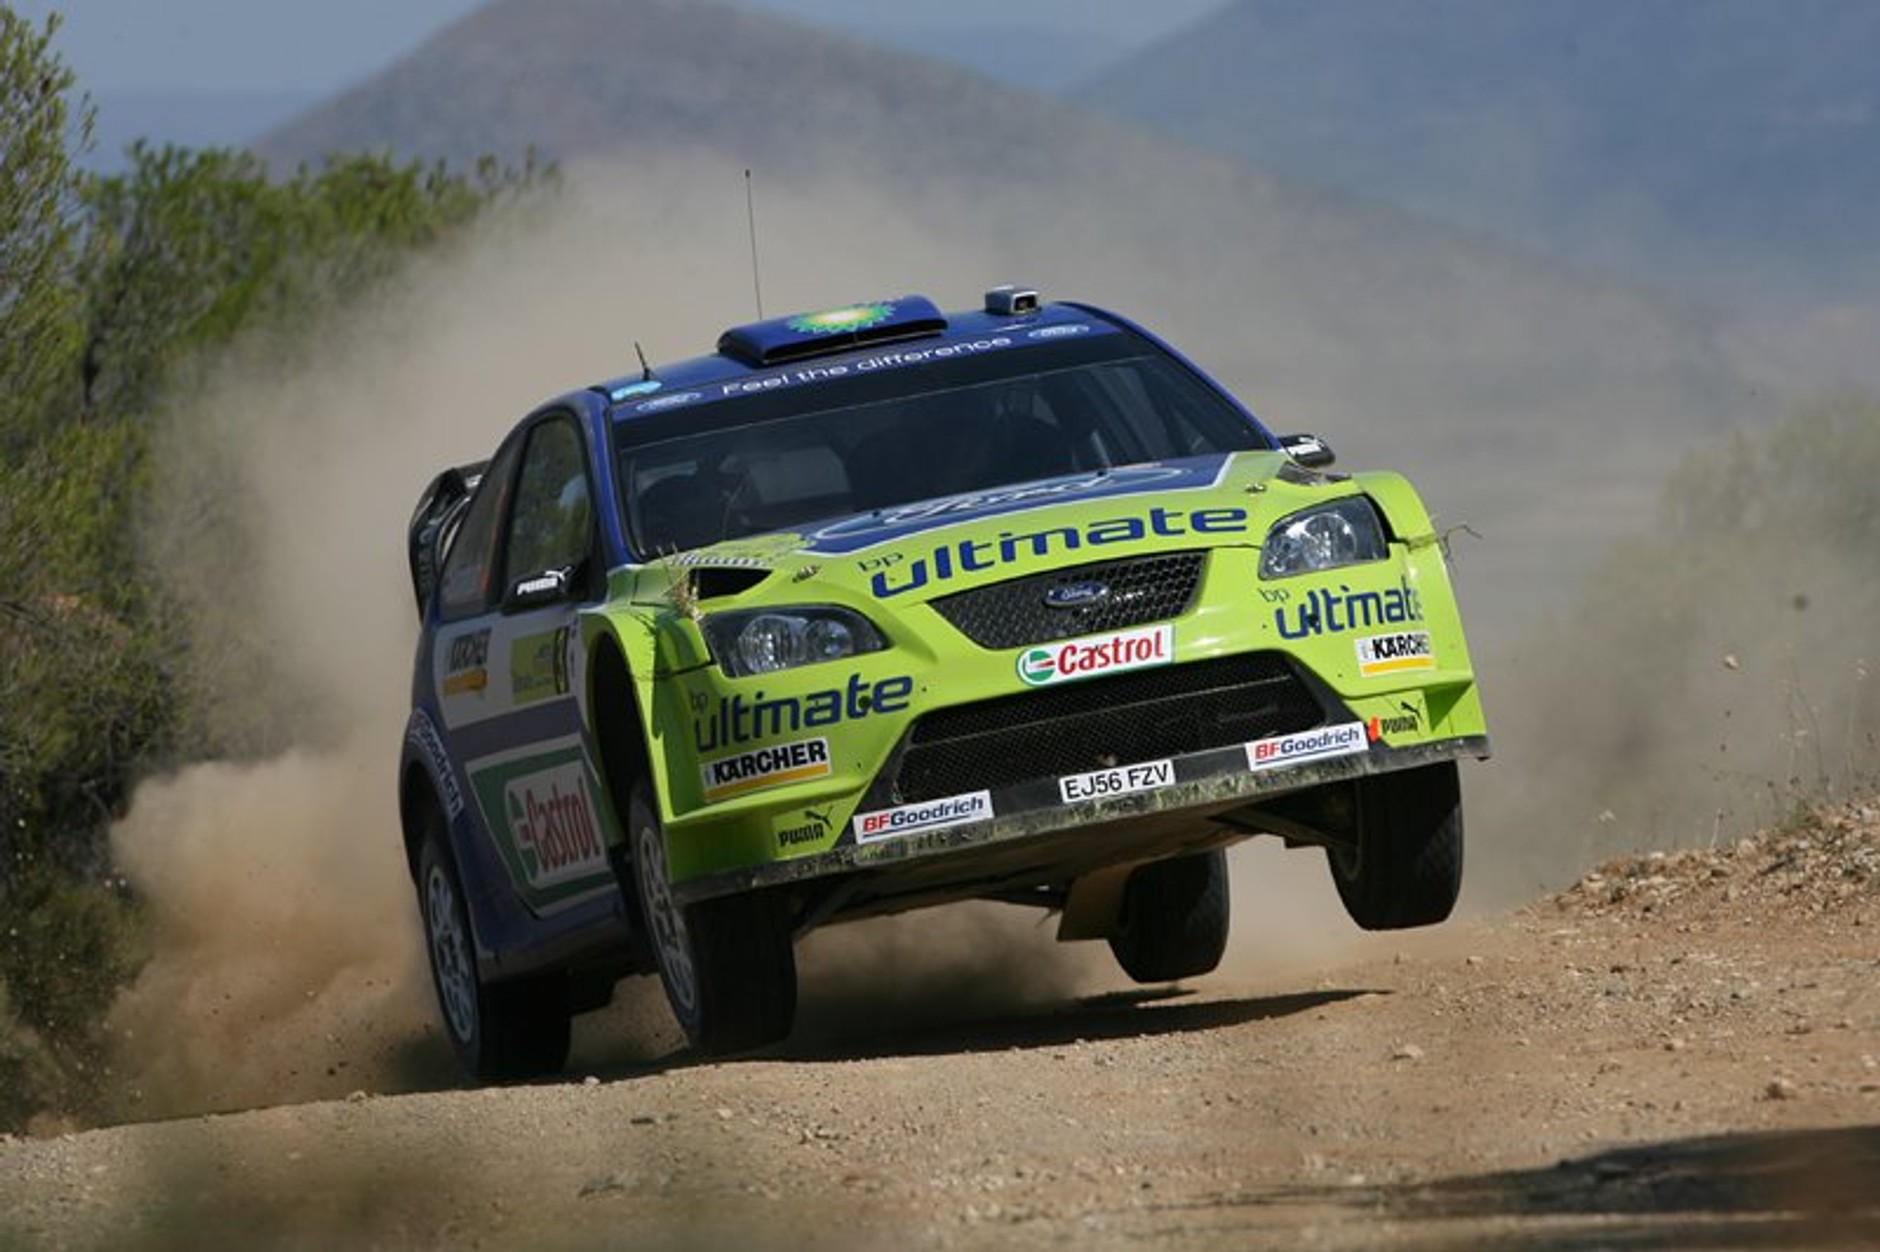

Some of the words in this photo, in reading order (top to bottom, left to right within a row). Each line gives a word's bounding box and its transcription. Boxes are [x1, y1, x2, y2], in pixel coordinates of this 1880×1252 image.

[722, 374, 789, 396] Feel
[797, 365, 848, 382] the
[857, 337, 1012, 371] difference
[858, 553, 904, 573] bp
[870, 507, 1248, 599] ultimate
[1258, 587, 1290, 604] bp
[1057, 629, 1165, 676] Castrol
[695, 673, 913, 753] ultimate
[1254, 727, 1361, 760] BFGoodrich
[1063, 771, 1123, 800] EJ56
[1127, 763, 1169, 788] FZV
[525, 775, 602, 873] Castrol
[862, 796, 984, 833] BFGoodrich
[777, 822, 825, 847] PUMA
